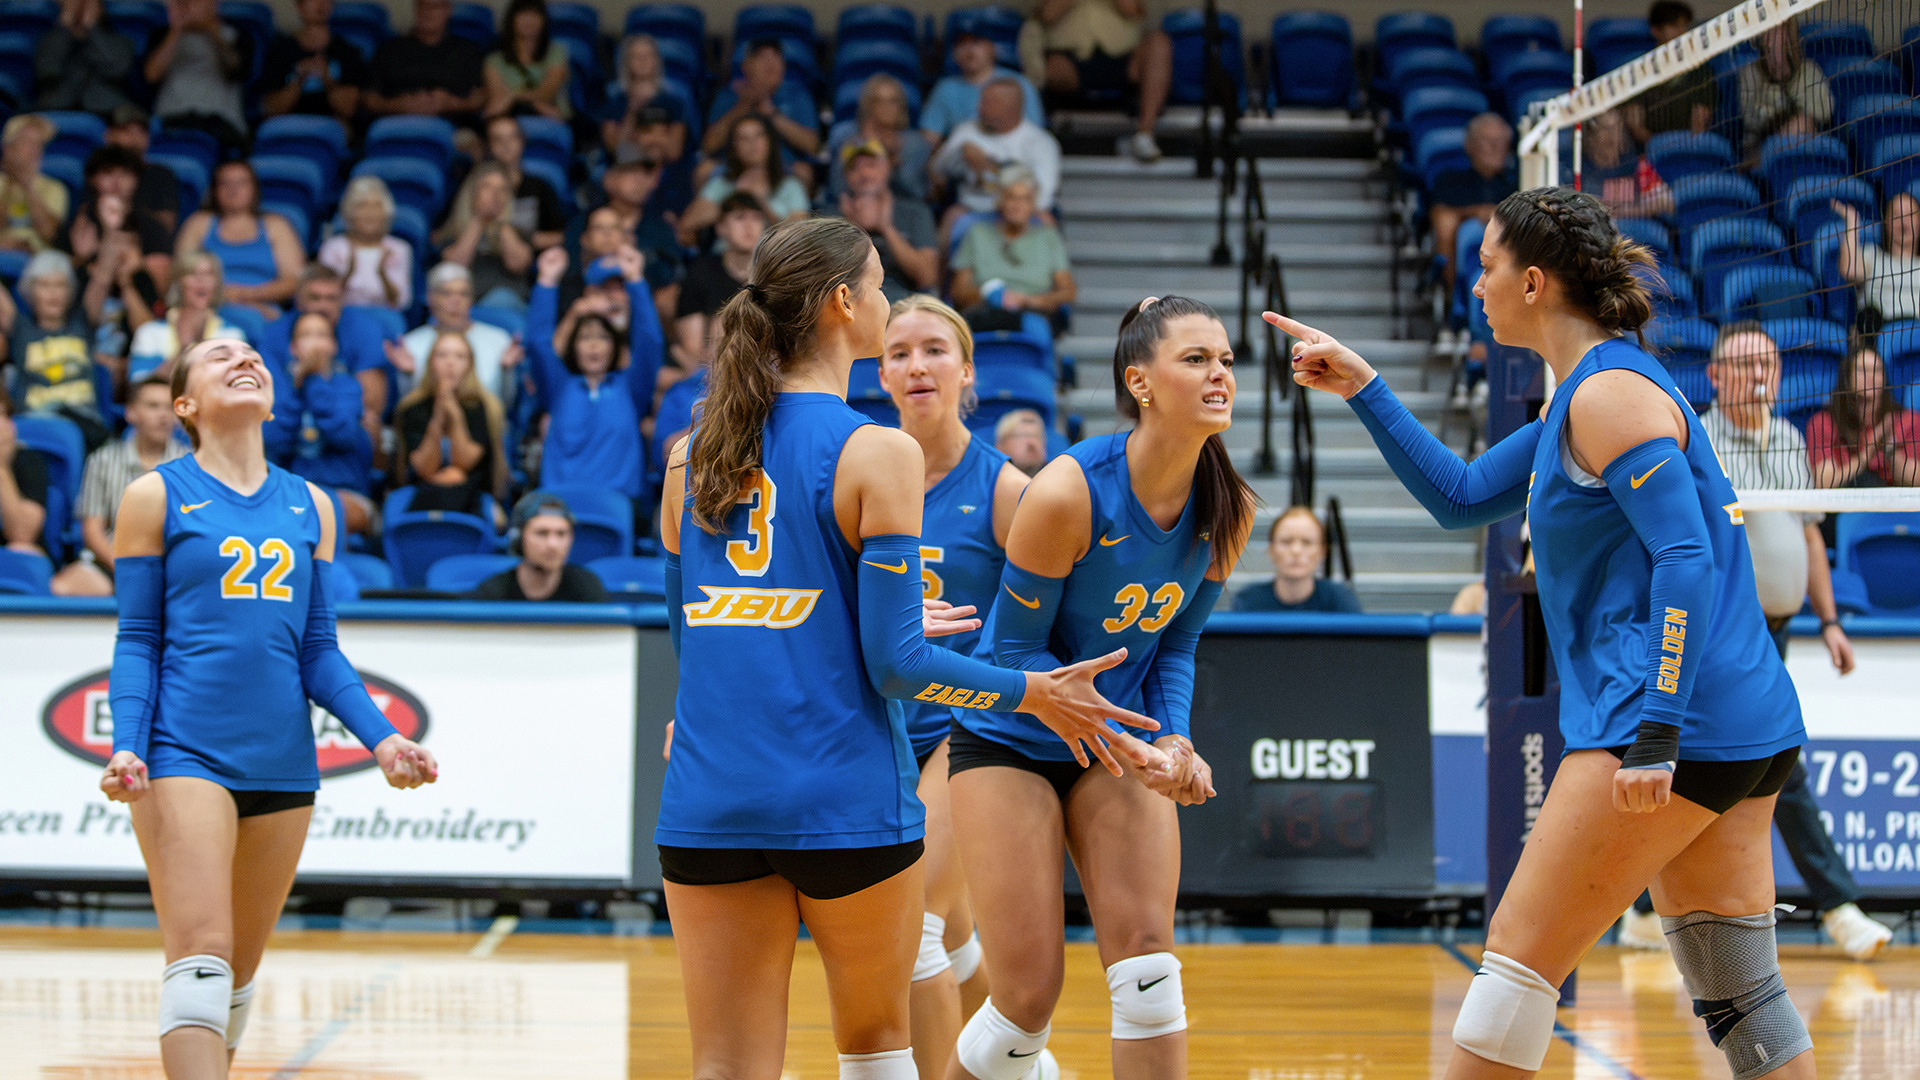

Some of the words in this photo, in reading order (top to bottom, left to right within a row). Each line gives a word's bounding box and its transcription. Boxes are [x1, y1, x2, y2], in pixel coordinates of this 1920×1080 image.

[725, 466, 777, 577] 3
[219, 536, 294, 602] 22
[682, 585, 824, 629] JBU
[1102, 582, 1185, 634] 33
[1657, 606, 1688, 695] GOLDEN
[913, 682, 1001, 710] EAGLES
[1250, 737, 1376, 780] GUEST
[1798, 750, 1920, 798] 79-2
[309, 805, 536, 851] Embroidery
[1835, 842, 1920, 872] ILOA
